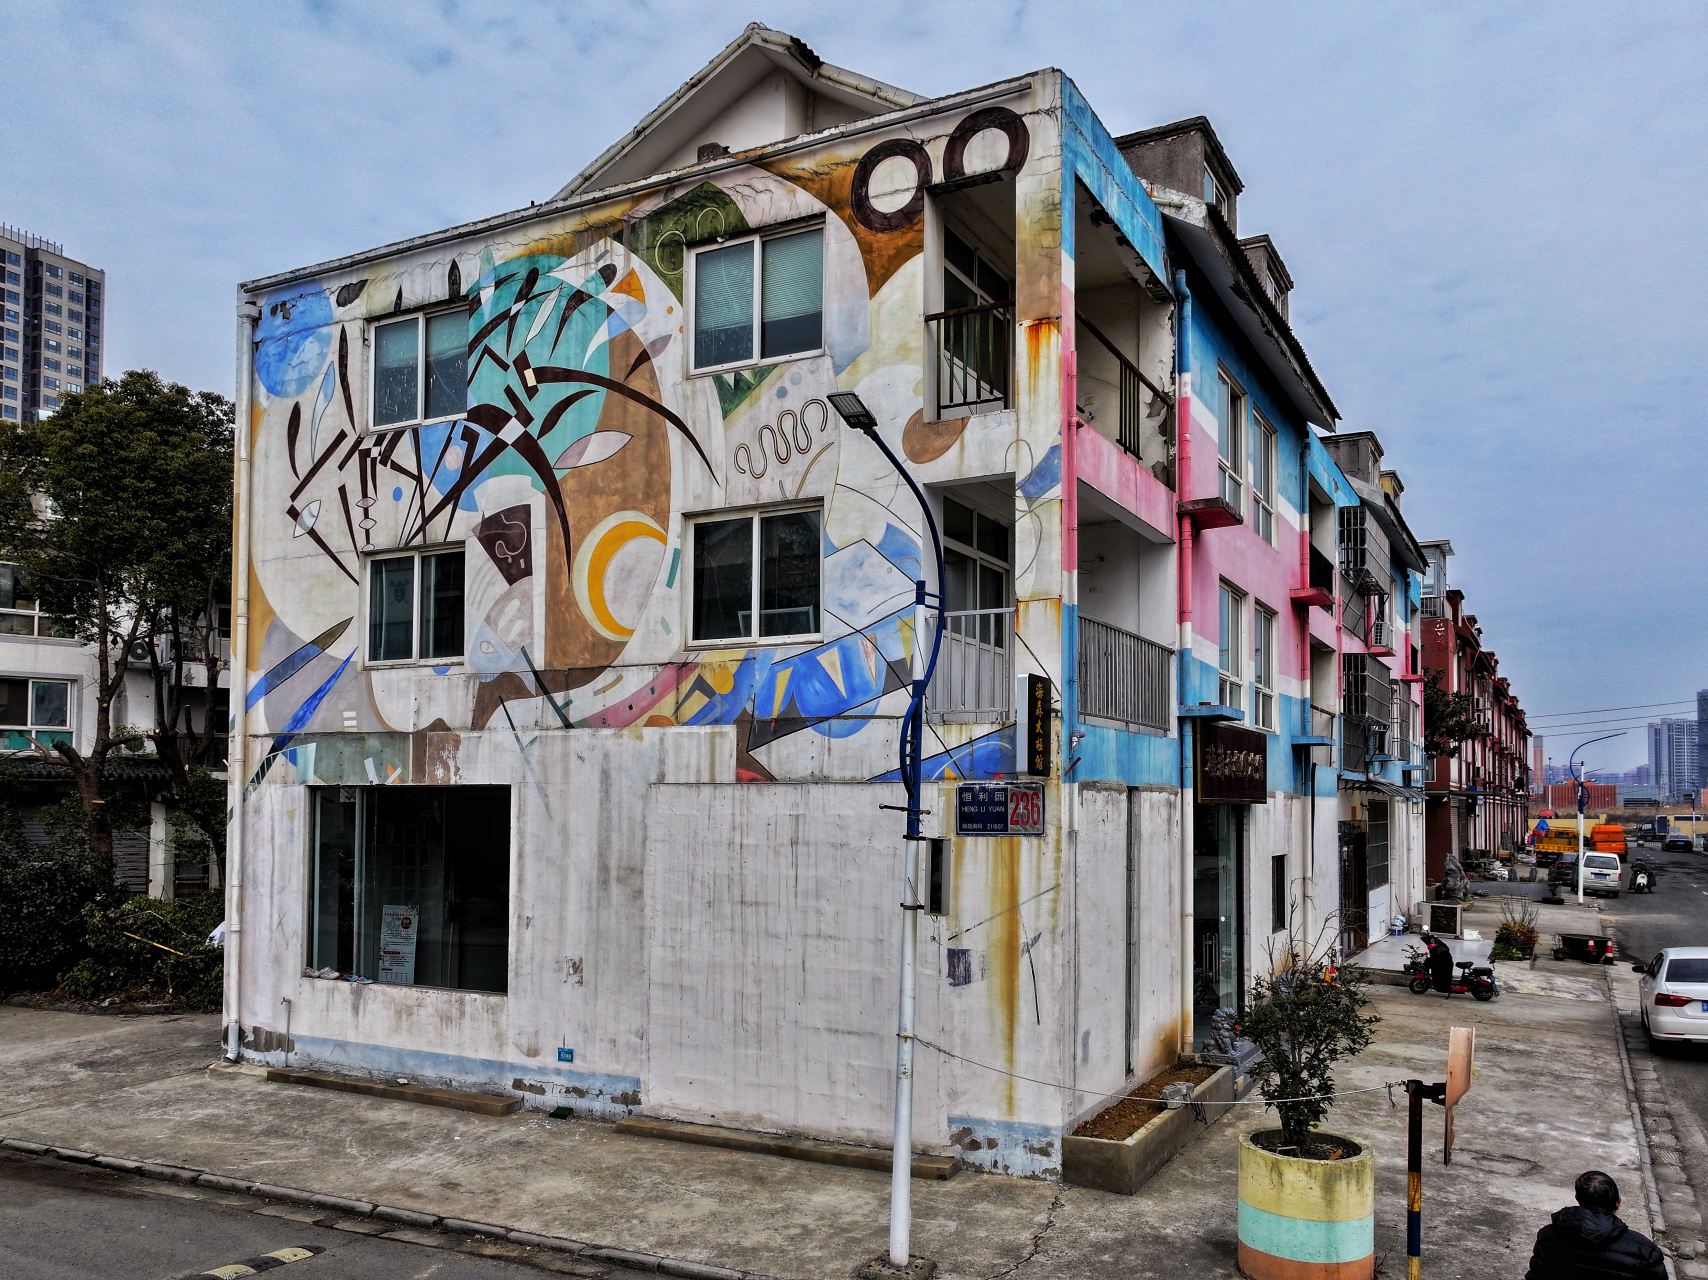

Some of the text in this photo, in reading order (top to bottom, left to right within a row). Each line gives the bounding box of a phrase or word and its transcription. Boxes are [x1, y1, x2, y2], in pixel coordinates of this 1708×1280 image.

[961, 791, 1005, 802] 恒利园
[961, 805, 1005, 813] HENG LI YUAN
[1010, 792, 1040, 826] 236
